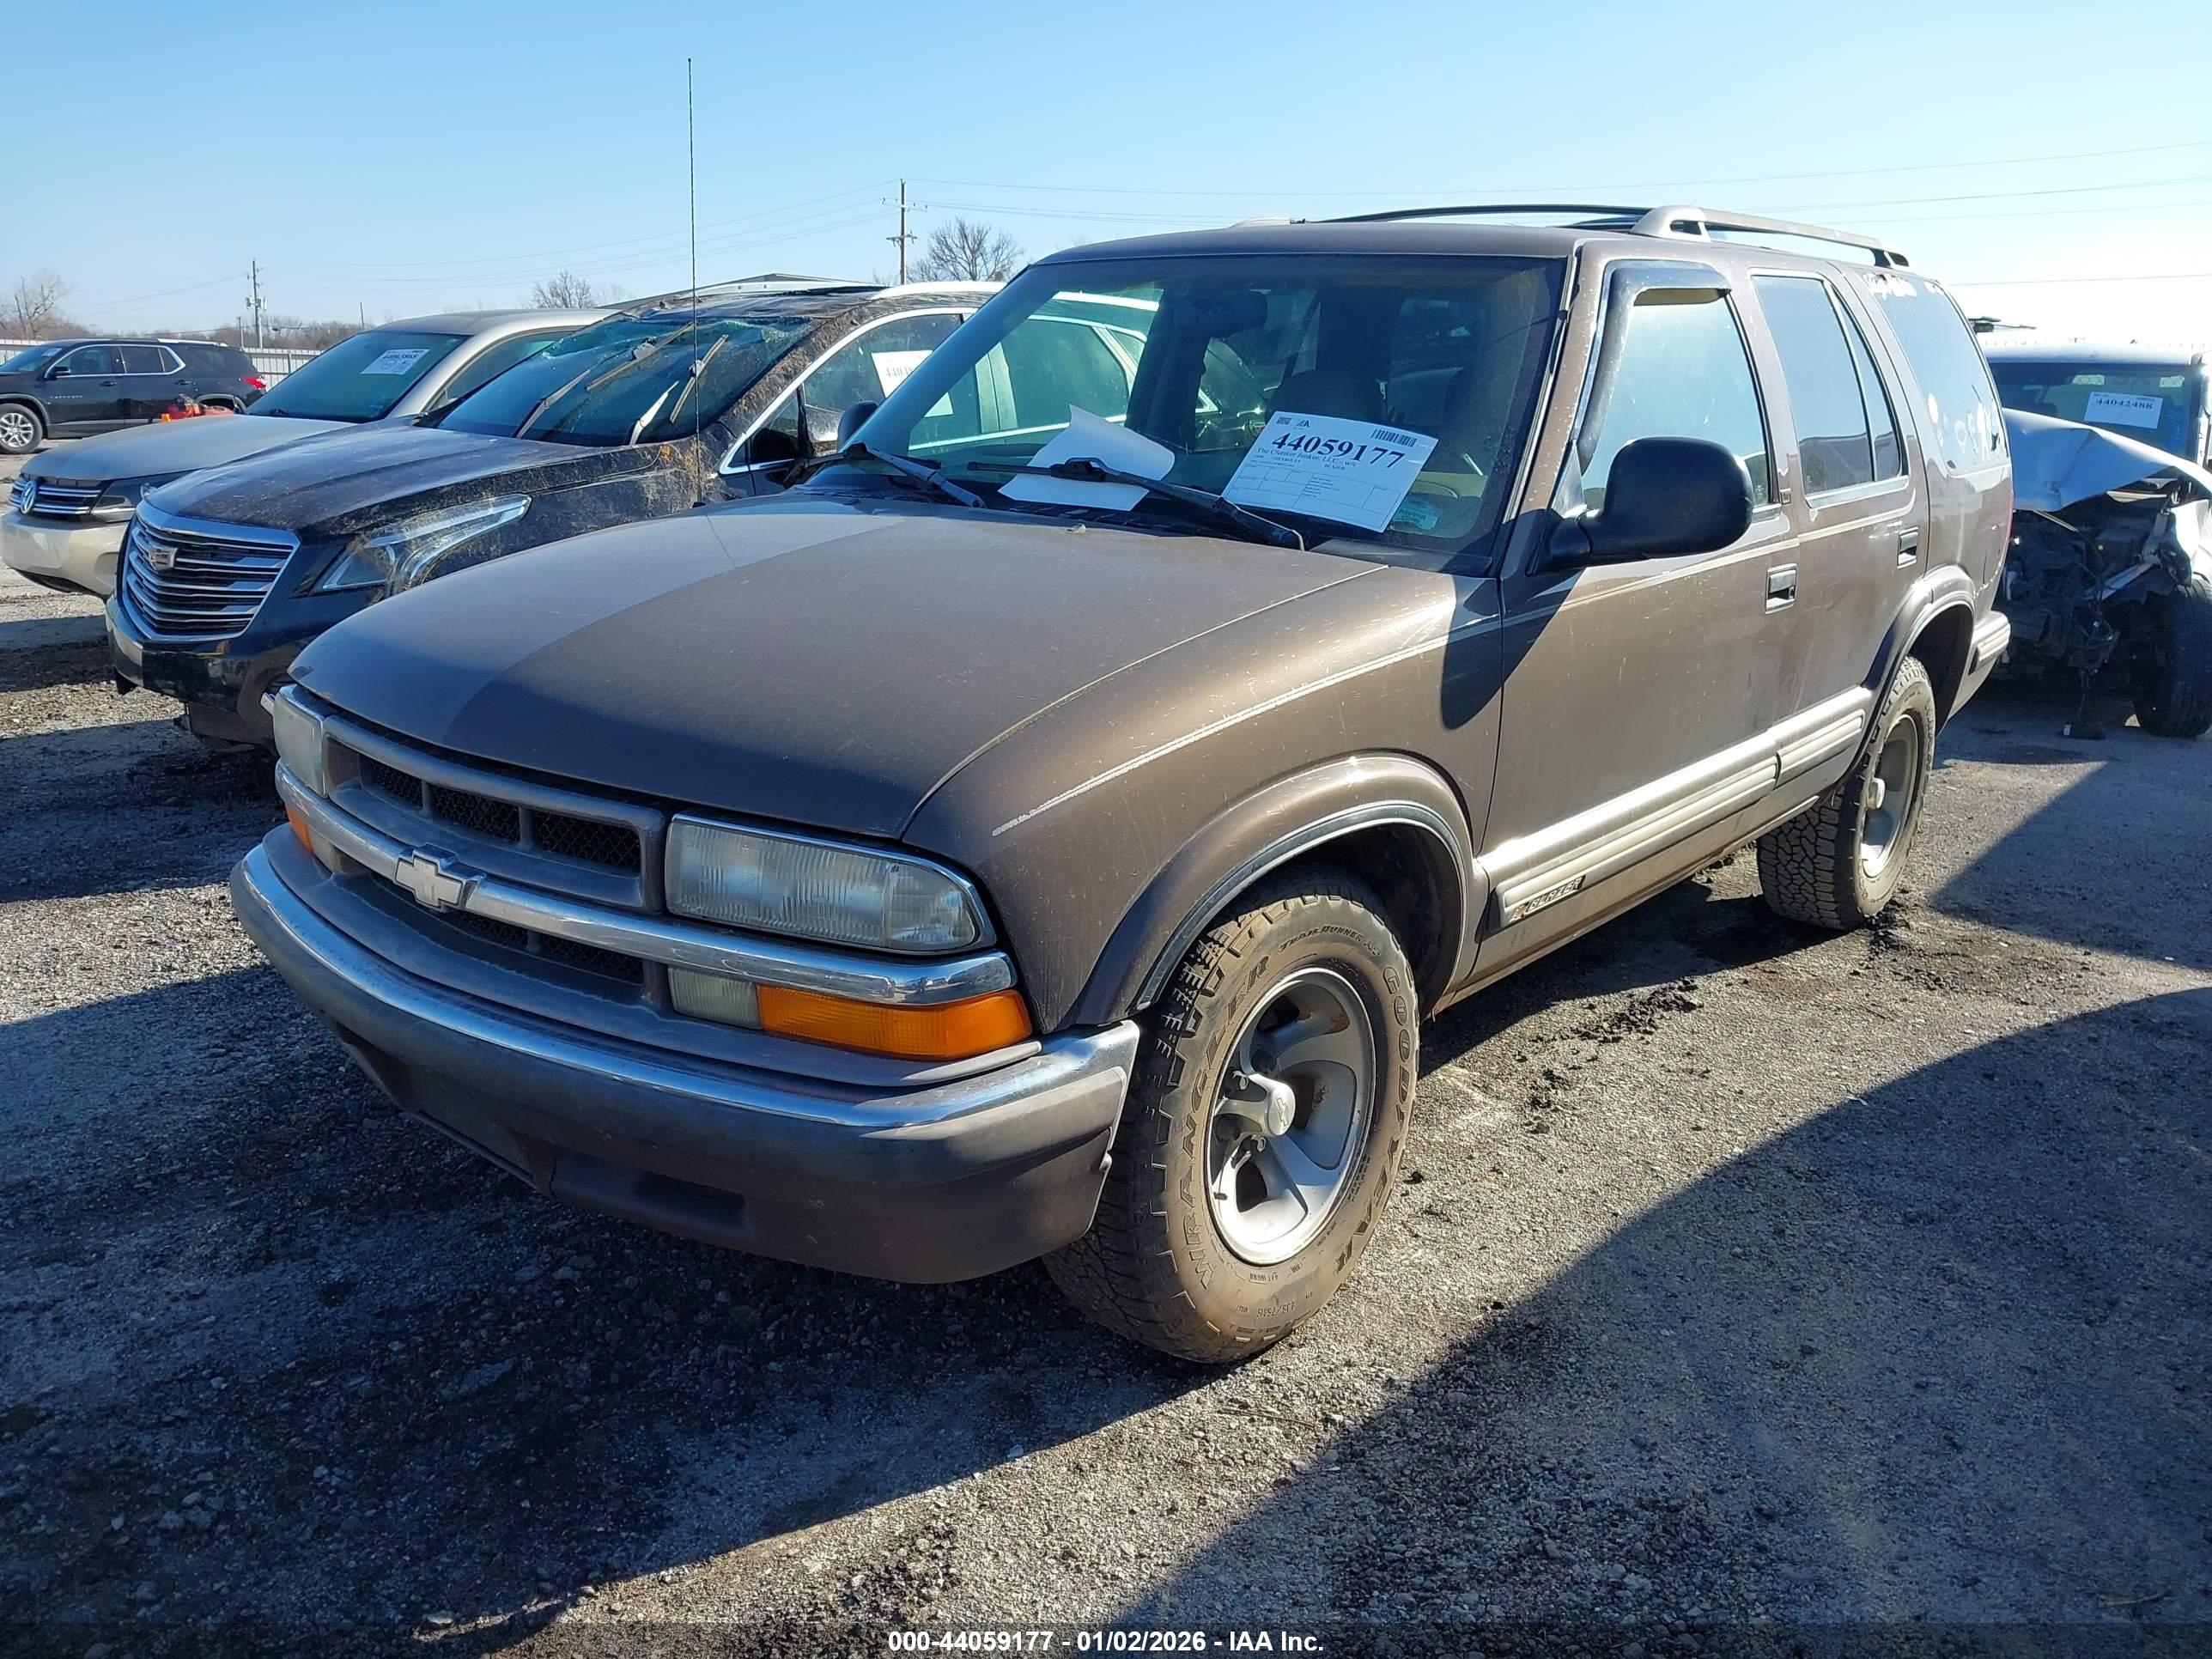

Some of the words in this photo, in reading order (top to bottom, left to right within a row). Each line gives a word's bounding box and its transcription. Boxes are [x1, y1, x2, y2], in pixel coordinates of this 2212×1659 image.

[1272, 432, 1406, 469] 44059177
[1179, 955, 1271, 1290] WRANGLER
[1336, 966, 1411, 1273] GOODYEAR
